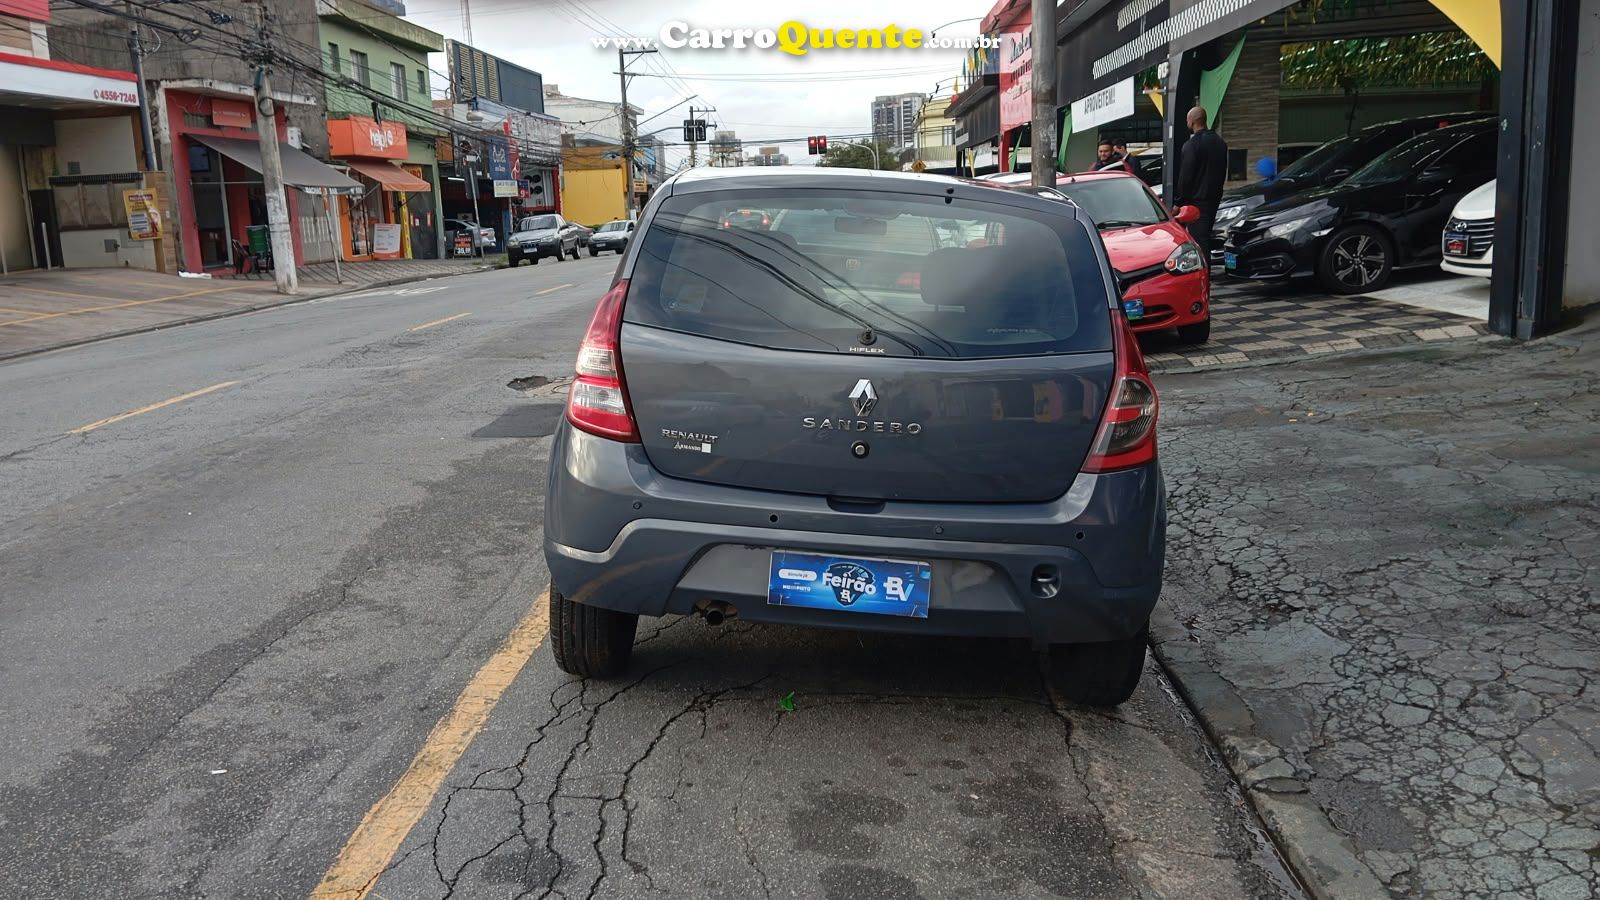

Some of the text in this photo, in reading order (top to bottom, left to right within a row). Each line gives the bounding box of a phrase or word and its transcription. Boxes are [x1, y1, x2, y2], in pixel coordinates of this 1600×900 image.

[849, 346, 885, 354] HIFLEX
[802, 416, 923, 435] SANDERO
[661, 428, 719, 443] RENAULT
[822, 571, 877, 595] Feirão
